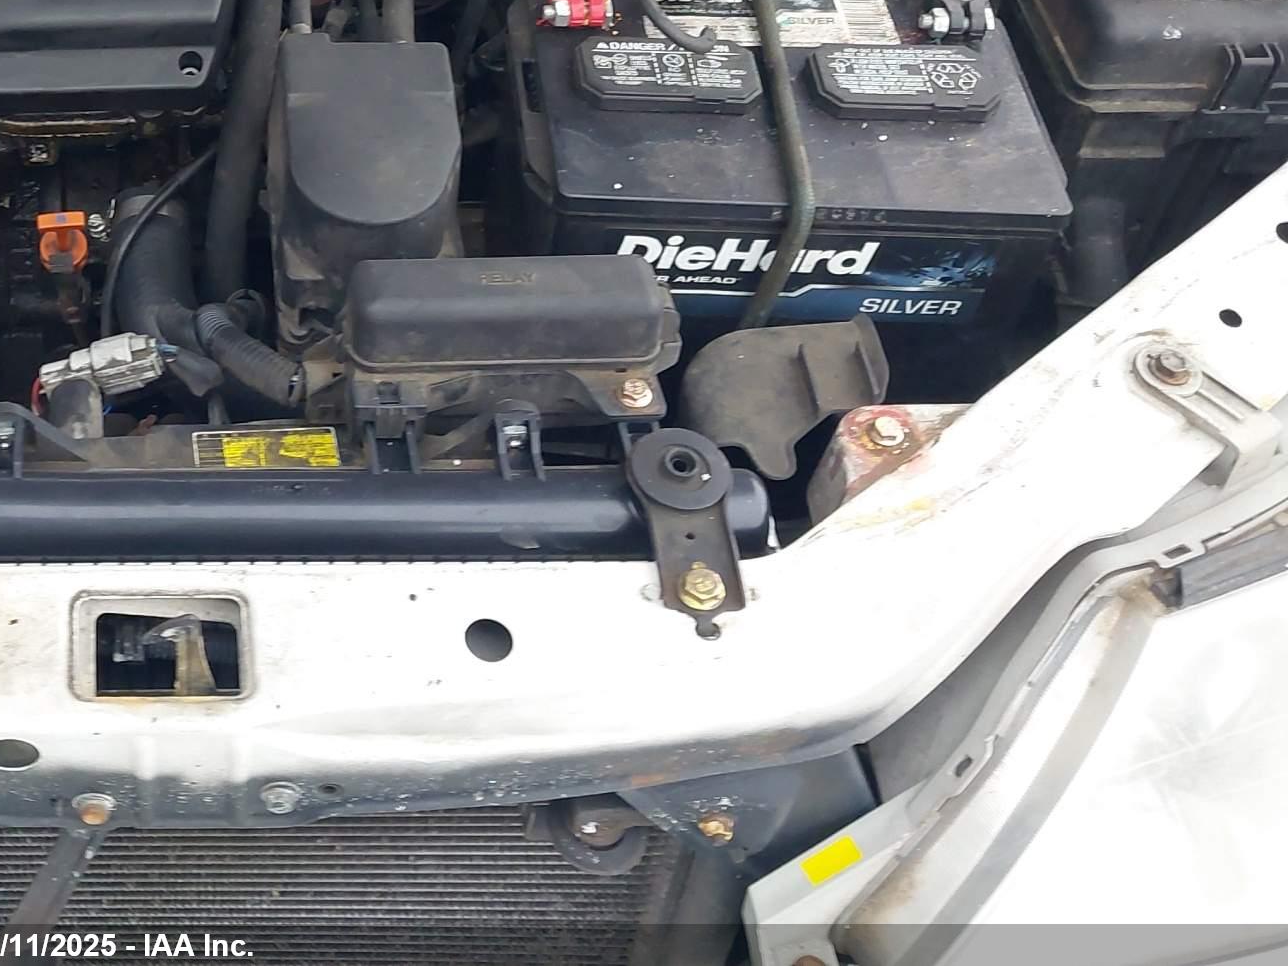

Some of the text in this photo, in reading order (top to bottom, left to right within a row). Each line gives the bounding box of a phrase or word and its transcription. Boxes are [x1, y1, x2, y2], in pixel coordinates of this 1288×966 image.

[784, 16, 834, 25] SILVER
[609, 42, 666, 51] DANGER
[672, 275, 738, 284] AHEAD
[859, 288, 962, 315] SILVER
